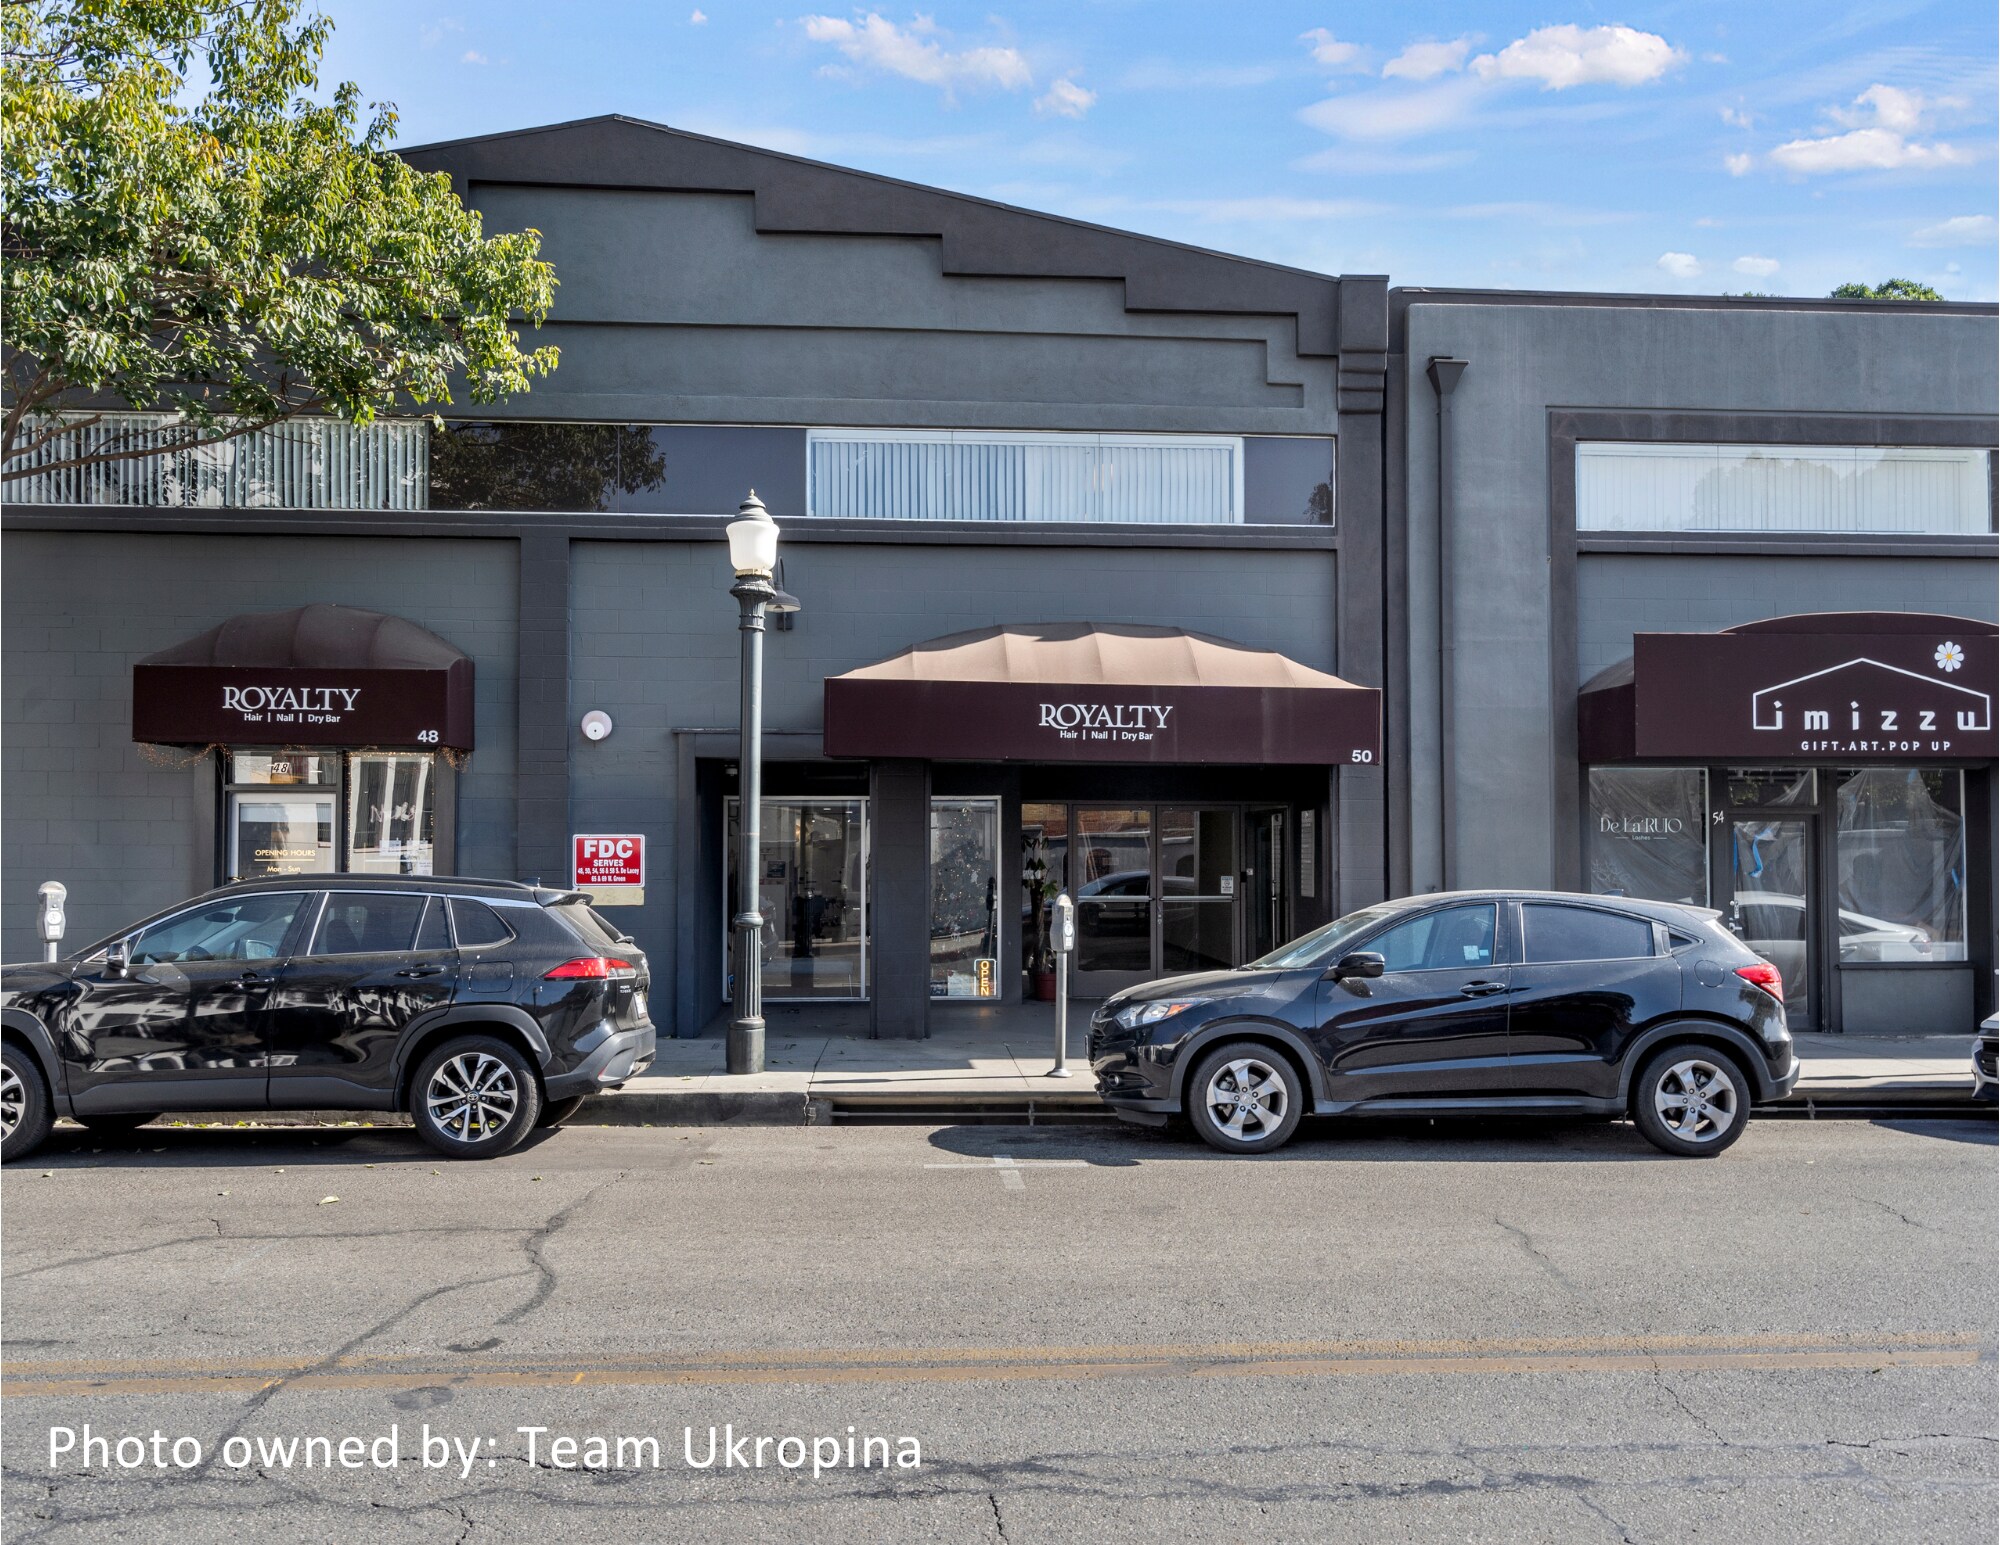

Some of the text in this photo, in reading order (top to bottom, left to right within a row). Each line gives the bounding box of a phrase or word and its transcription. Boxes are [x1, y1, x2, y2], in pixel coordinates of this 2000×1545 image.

[222, 686, 361, 712] ROYALTY
[243, 713, 263, 721] Hair
[276, 713, 294, 722] Nail
[307, 714, 325, 724] Dry
[325, 714, 341, 723] Bar
[1039, 703, 1174, 729] ROYALTY
[1773, 700, 1976, 731] imizzu
[417, 730, 439, 743] 48
[1060, 731, 1078, 739] Hair
[1091, 731, 1108, 739] Nail
[1121, 732, 1138, 741] Dry
[1138, 732, 1153, 740] Bar
[1801, 740, 1951, 751] GIFT.ART.POP UP
[1351, 749, 1372, 763] 50
[273, 763, 288, 773] 48
[1712, 810, 1725, 825] 54
[1600, 817, 1620, 833] De
[290, 849, 316, 857] HOURS
[584, 839, 633, 859] FDC
[266, 865, 281, 873] Mon
[593, 859, 624, 867] SERVES
[980, 960, 990, 997] OPEN
